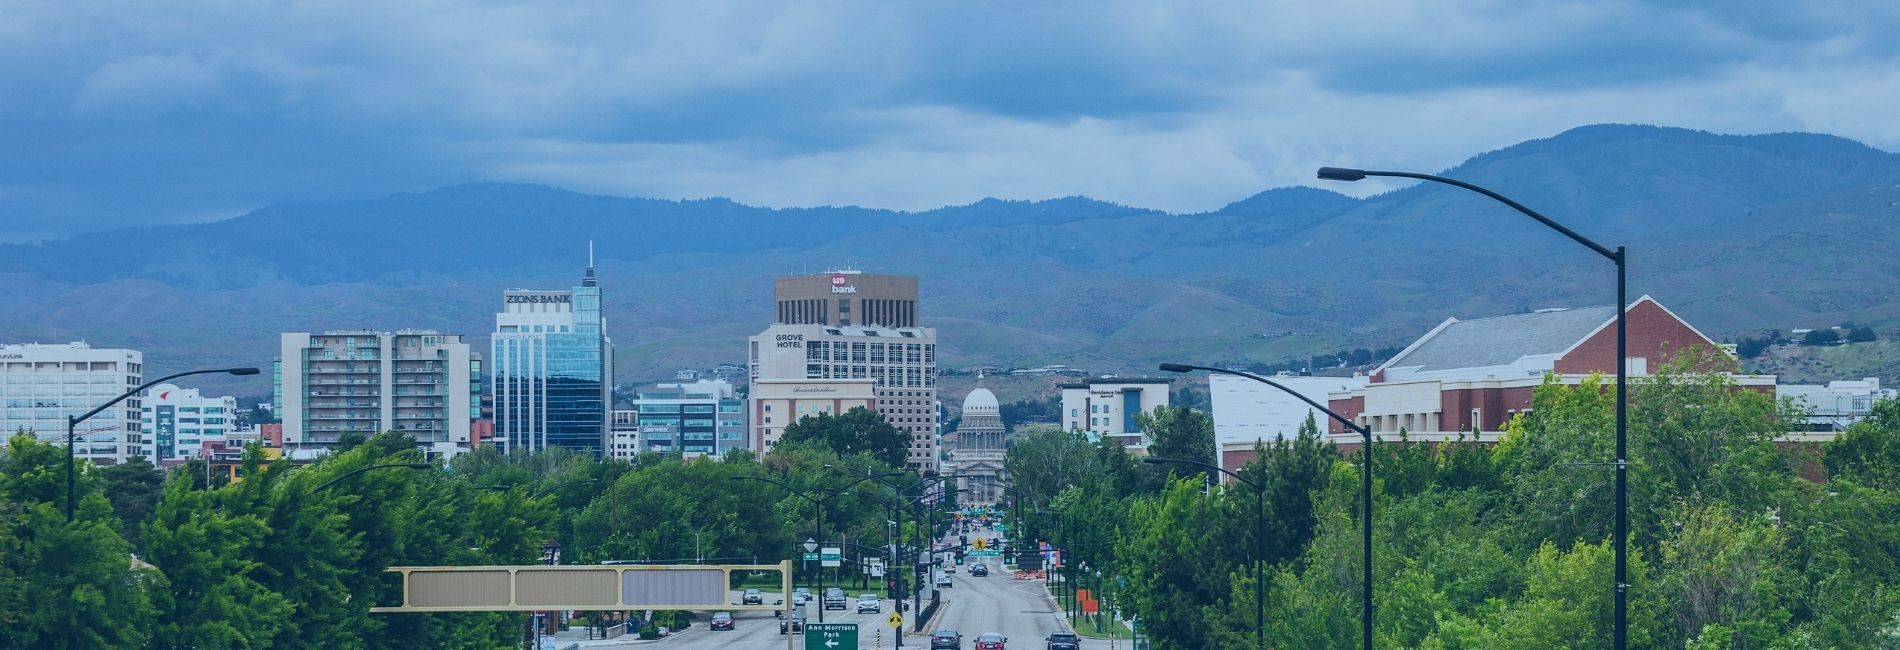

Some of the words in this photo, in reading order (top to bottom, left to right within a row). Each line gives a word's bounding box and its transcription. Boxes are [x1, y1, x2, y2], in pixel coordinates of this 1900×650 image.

[832, 285, 857, 293] bank
[506, 295, 539, 304] ZIONS
[540, 295, 571, 304] BANK
